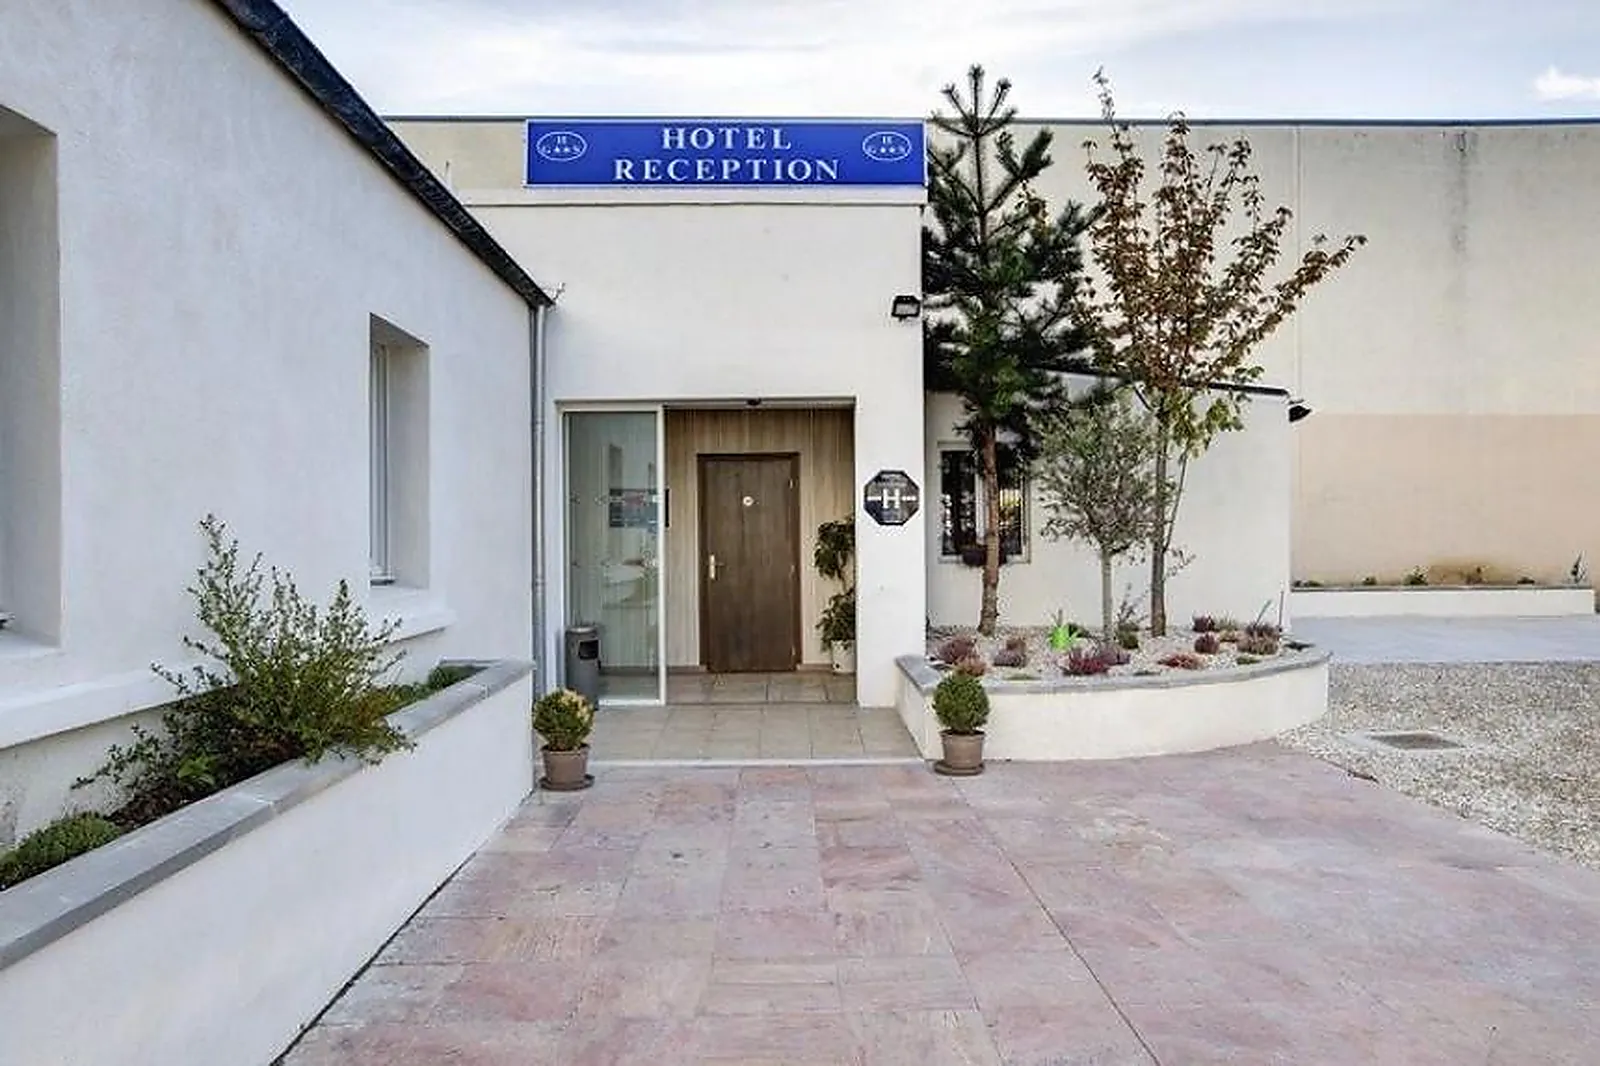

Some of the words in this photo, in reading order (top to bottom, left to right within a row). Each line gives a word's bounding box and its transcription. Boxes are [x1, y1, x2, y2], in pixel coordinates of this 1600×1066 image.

[662, 127, 792, 150] HOTEL
[614, 159, 839, 182] RECEPTION
[882, 488, 900, 509] H
